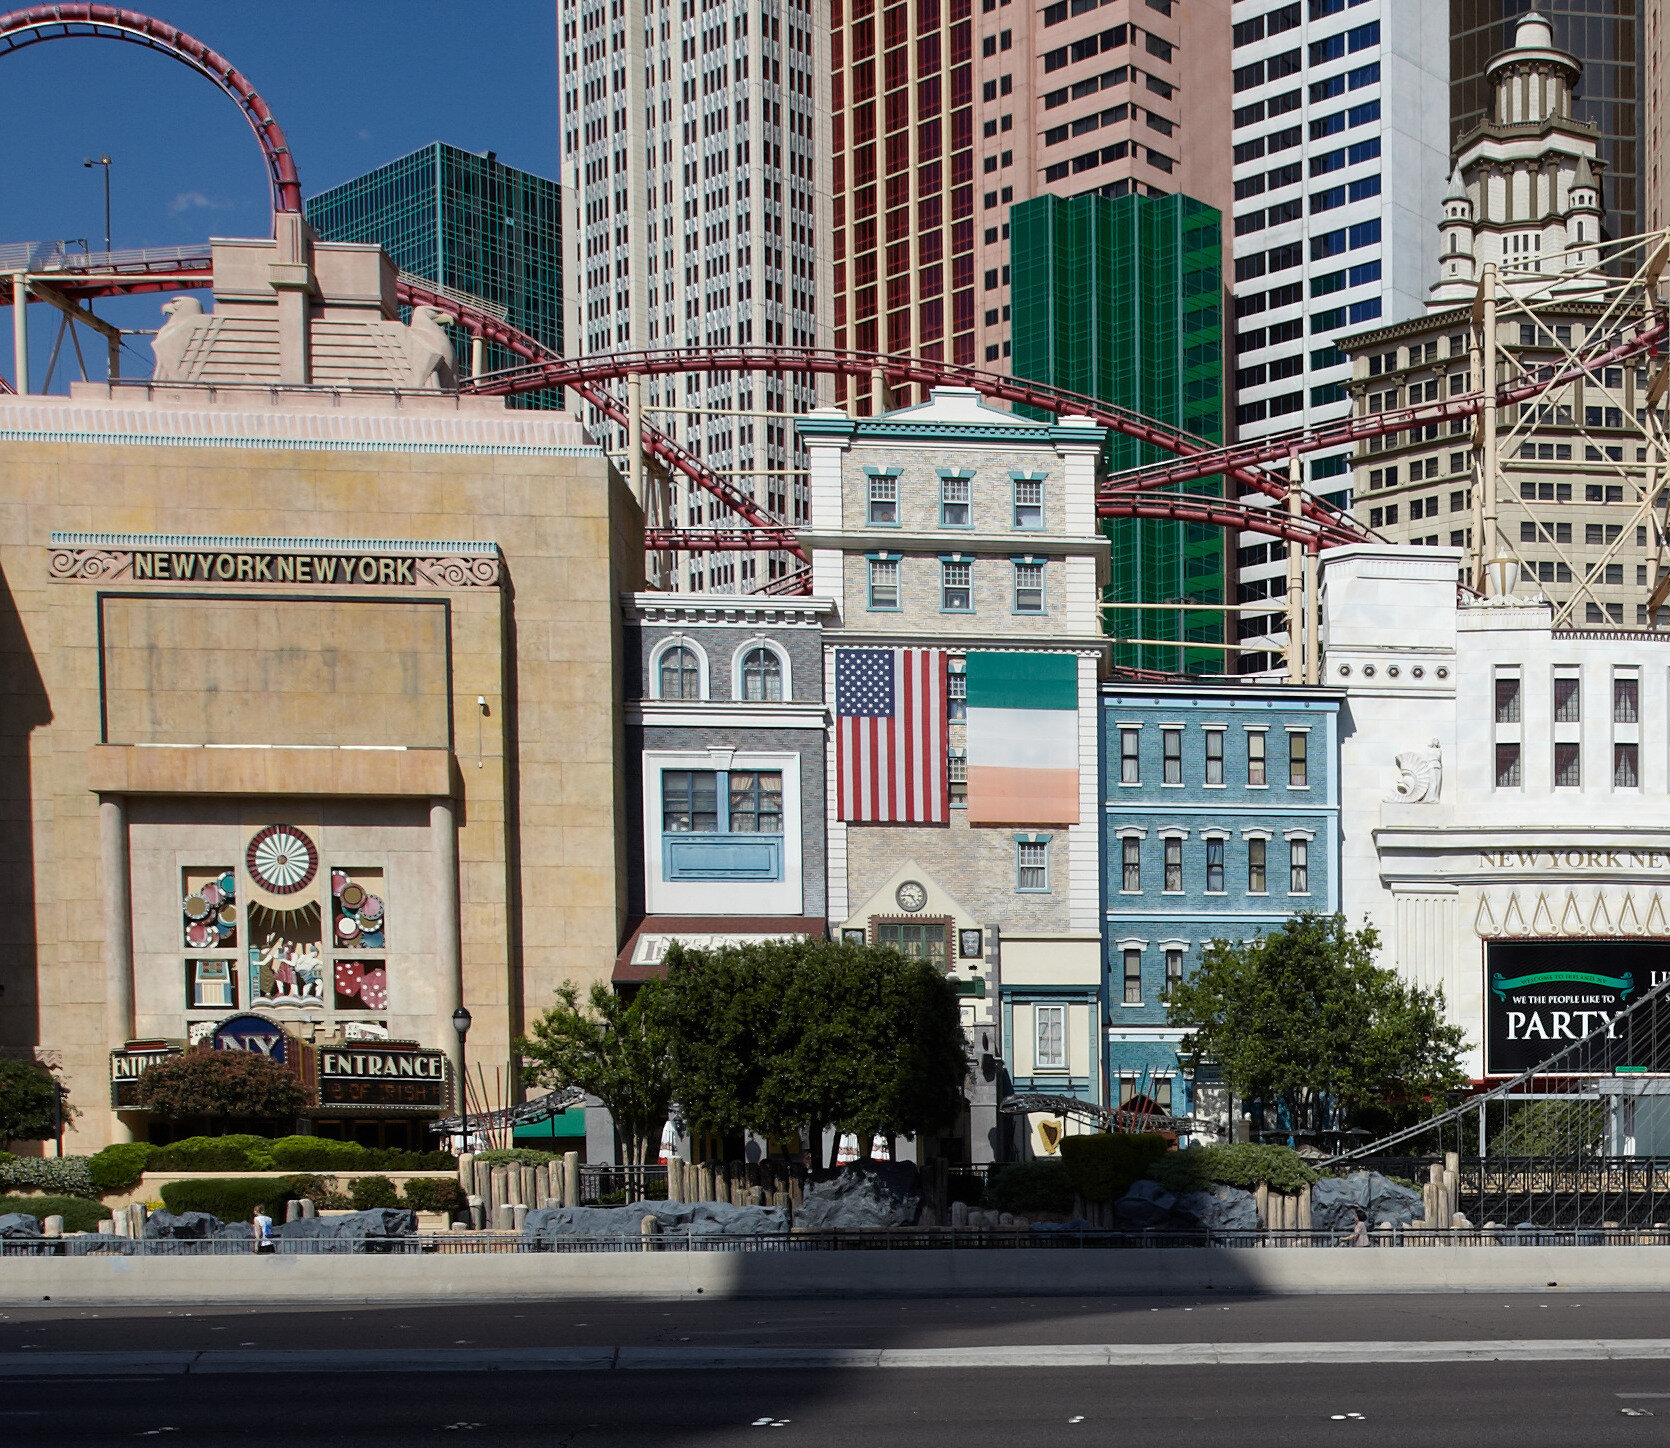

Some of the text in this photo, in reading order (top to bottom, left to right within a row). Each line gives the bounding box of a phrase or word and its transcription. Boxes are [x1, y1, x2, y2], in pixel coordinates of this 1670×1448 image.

[1479, 850, 1540, 868] NEW
[1546, 850, 1624, 869] YORK
[1512, 995, 1615, 1004] WE THE PEOPLE LIKE TO
[323, 1053, 441, 1077] ENTRANCE
